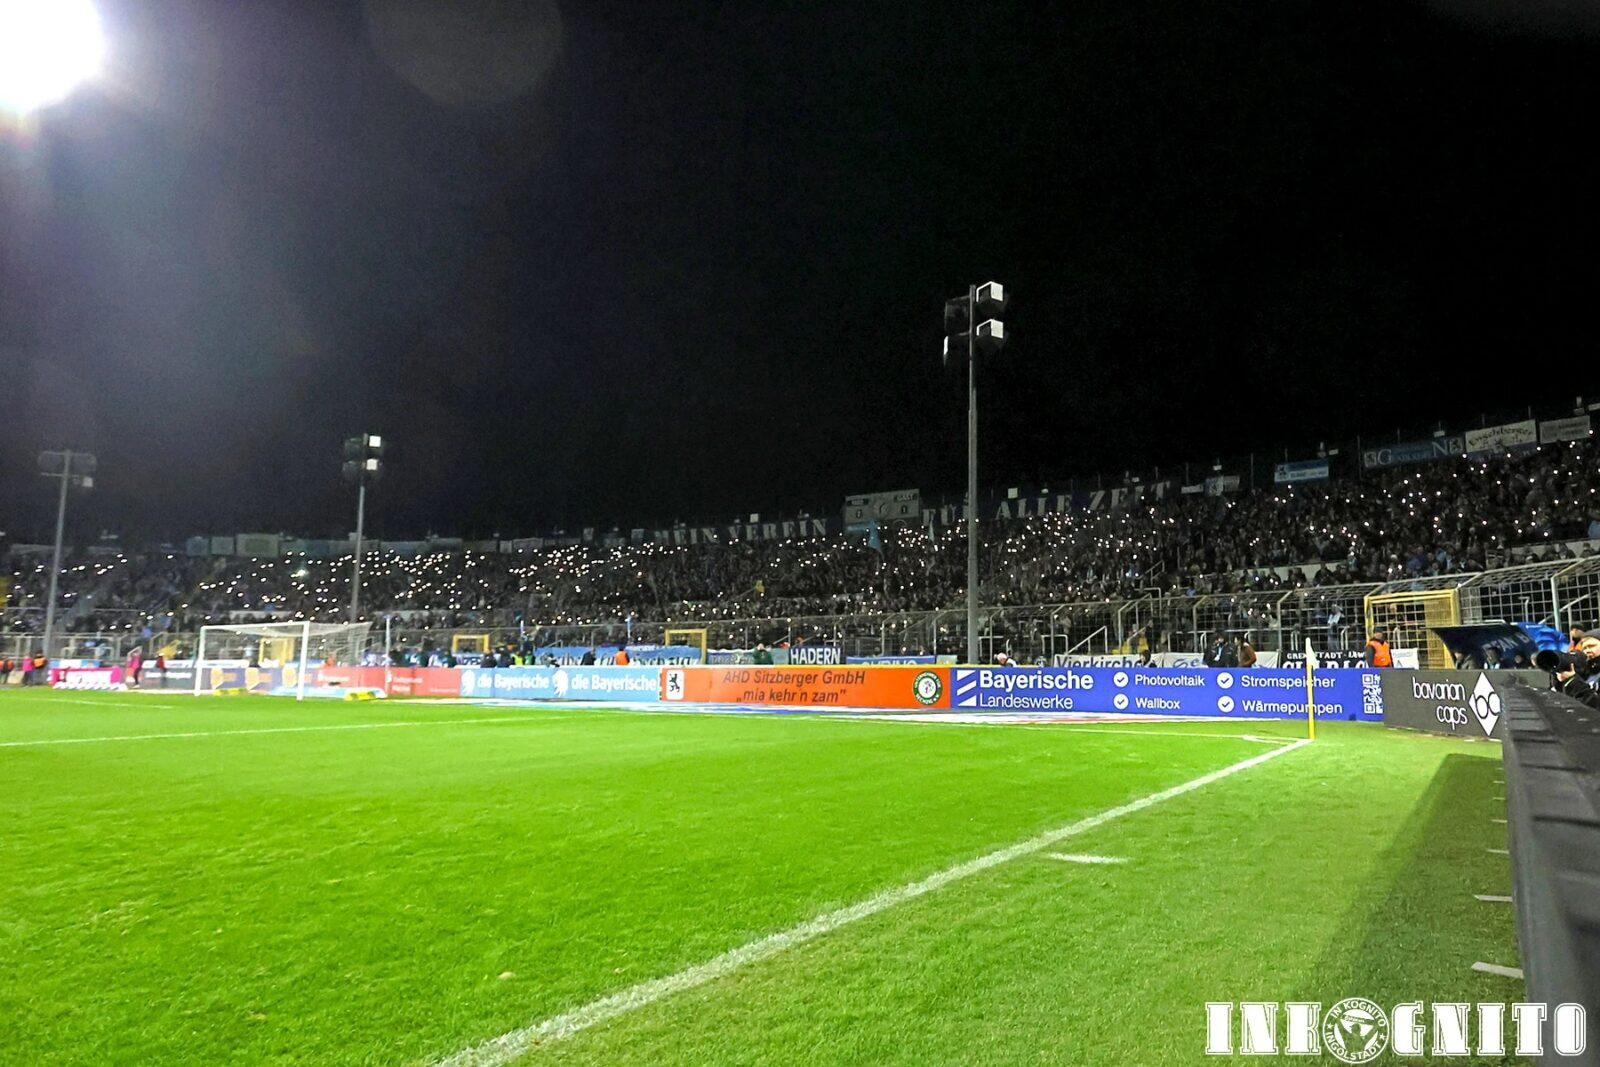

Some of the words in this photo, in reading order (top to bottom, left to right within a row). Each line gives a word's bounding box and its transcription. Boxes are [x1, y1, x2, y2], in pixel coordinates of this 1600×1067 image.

[728, 518, 827, 541] VEREIN
[790, 648, 841, 665] HADERN
[494, 674, 548, 691] Bayerische
[572, 674, 588, 690] die
[591, 674, 657, 691] Bayerische
[723, 671, 750, 684] AHD
[754, 670, 818, 685] Sitzberger
[822, 671, 865, 684] GmbH
[980, 670, 1094, 692] Bayerische
[1135, 674, 1205, 687] Photovoltaik
[1241, 675, 1336, 690] Stromspeiher
[1412, 676, 1466, 701] bavarian
[980, 694, 1073, 709] Landeswerke
[1135, 698, 1181, 710] Wallbox
[1436, 705, 1468, 731] caps
